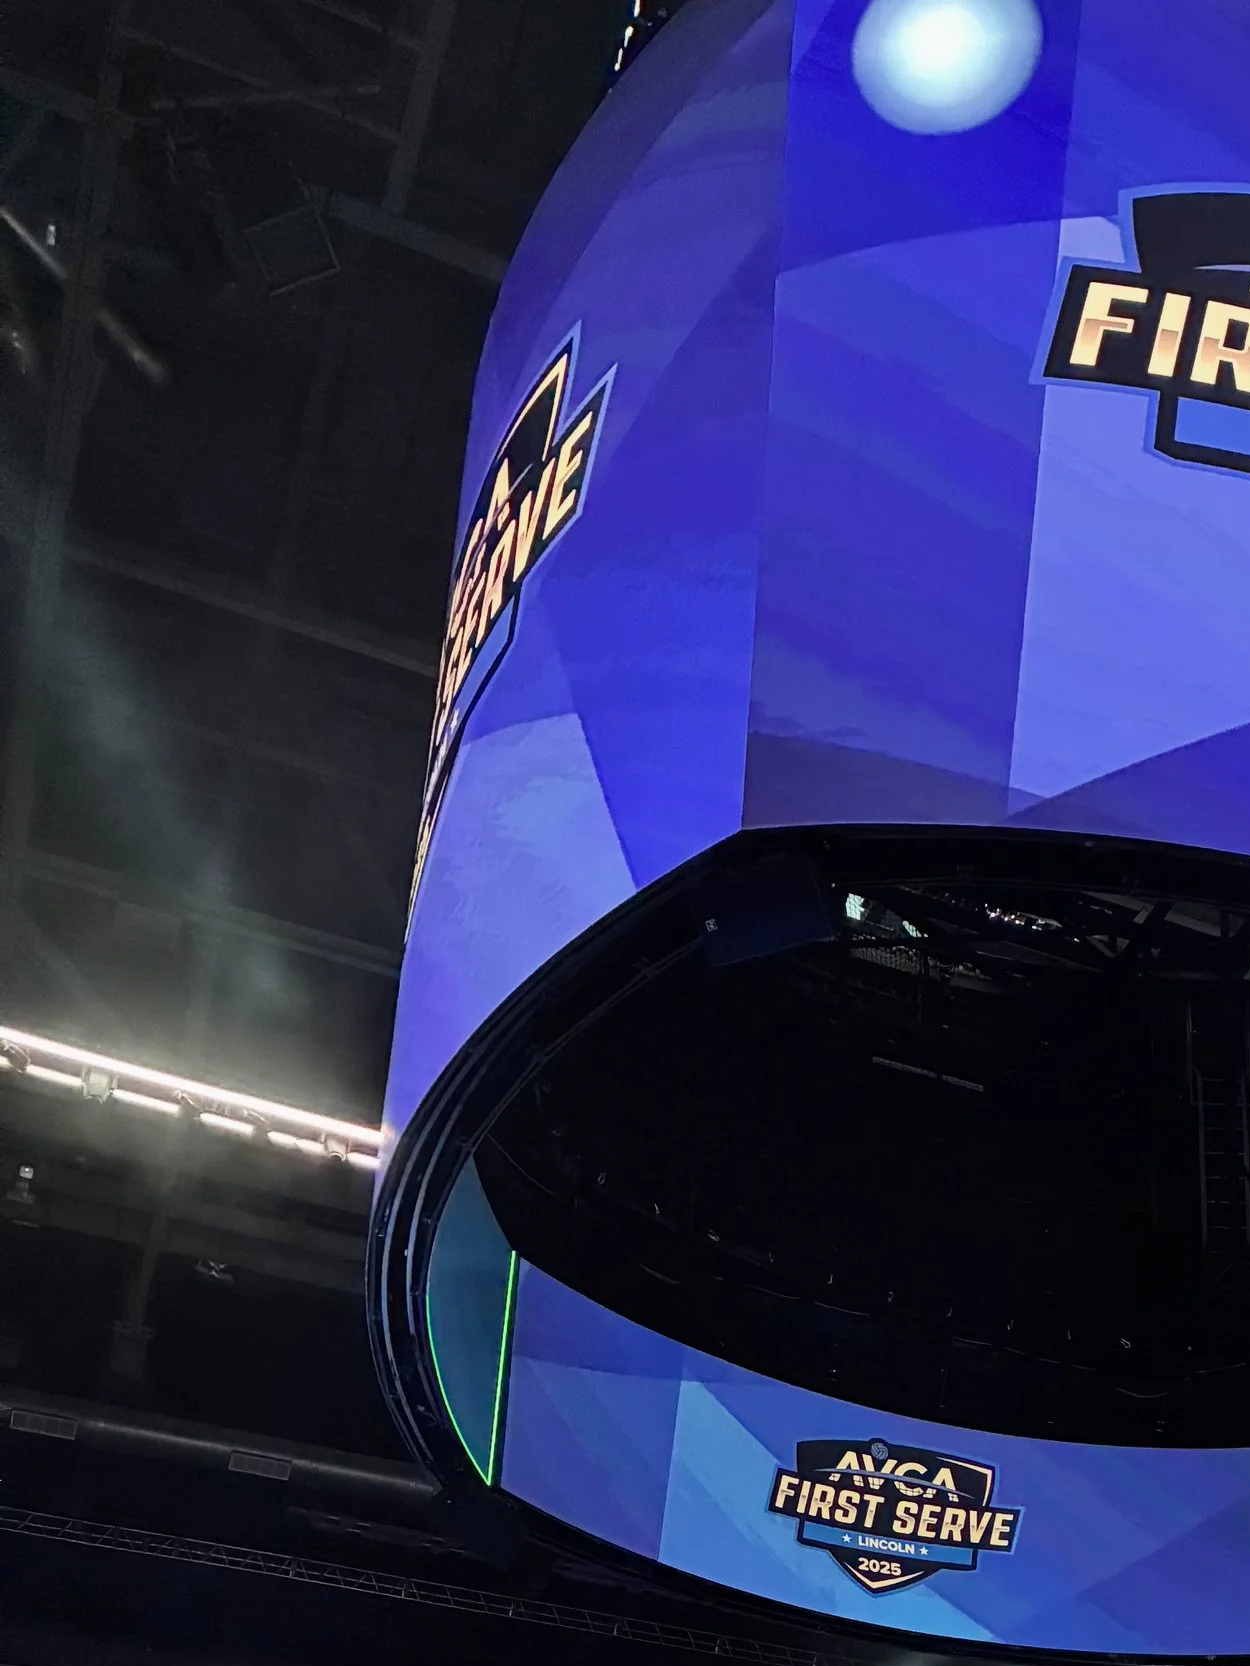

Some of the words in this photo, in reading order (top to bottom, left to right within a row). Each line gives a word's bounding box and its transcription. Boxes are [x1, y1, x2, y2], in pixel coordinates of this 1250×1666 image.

[829, 1450, 959, 1502] AVCA
[774, 1474, 884, 1528] FIRST
[892, 1501, 1015, 1546] SERVE
[857, 1535, 915, 1555] LINCOLN
[857, 1557, 902, 1576] 2025
